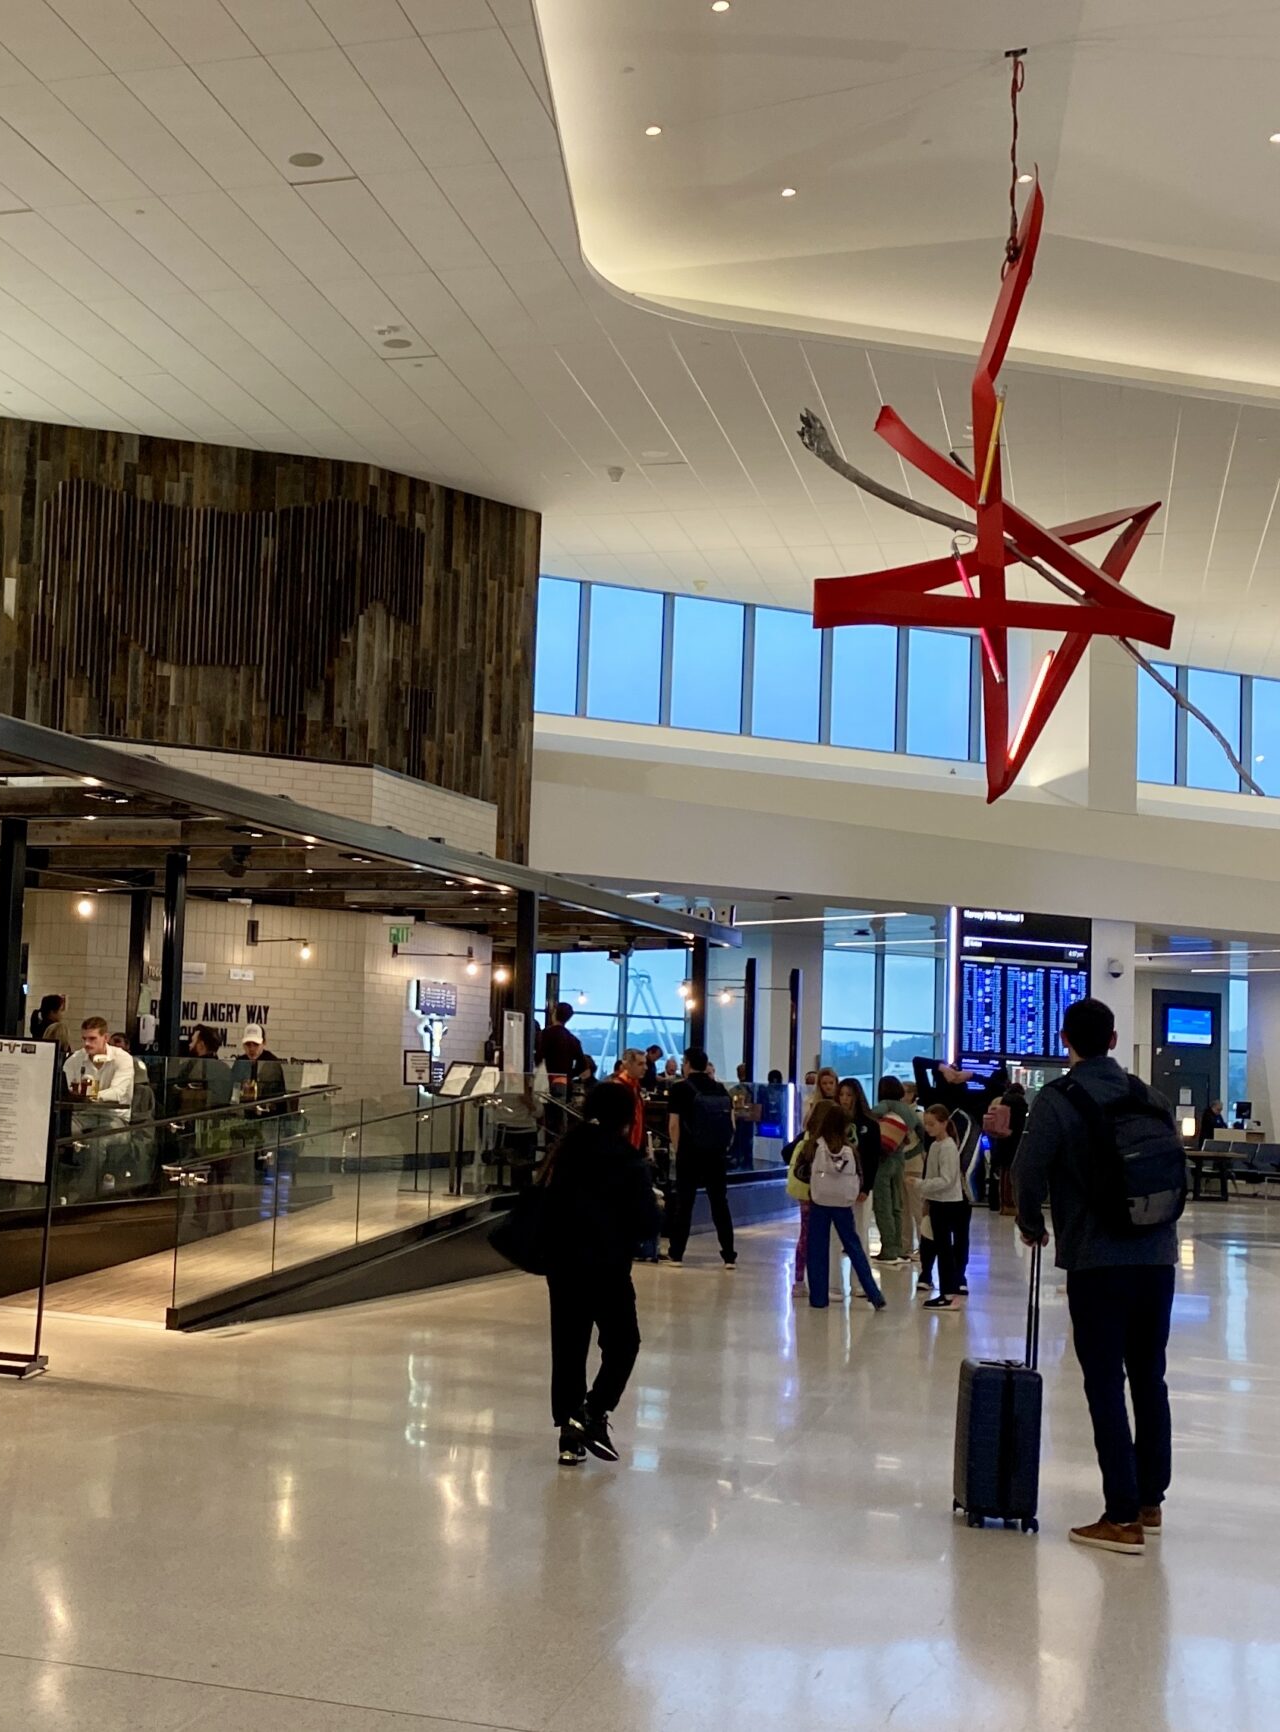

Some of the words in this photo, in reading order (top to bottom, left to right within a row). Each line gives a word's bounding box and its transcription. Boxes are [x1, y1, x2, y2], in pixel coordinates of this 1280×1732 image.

[389, 926, 410, 944] EXIT
[181, 1001, 198, 1021] NO
[202, 1001, 241, 1023] ANGRY
[246, 1004, 270, 1025] WAY
